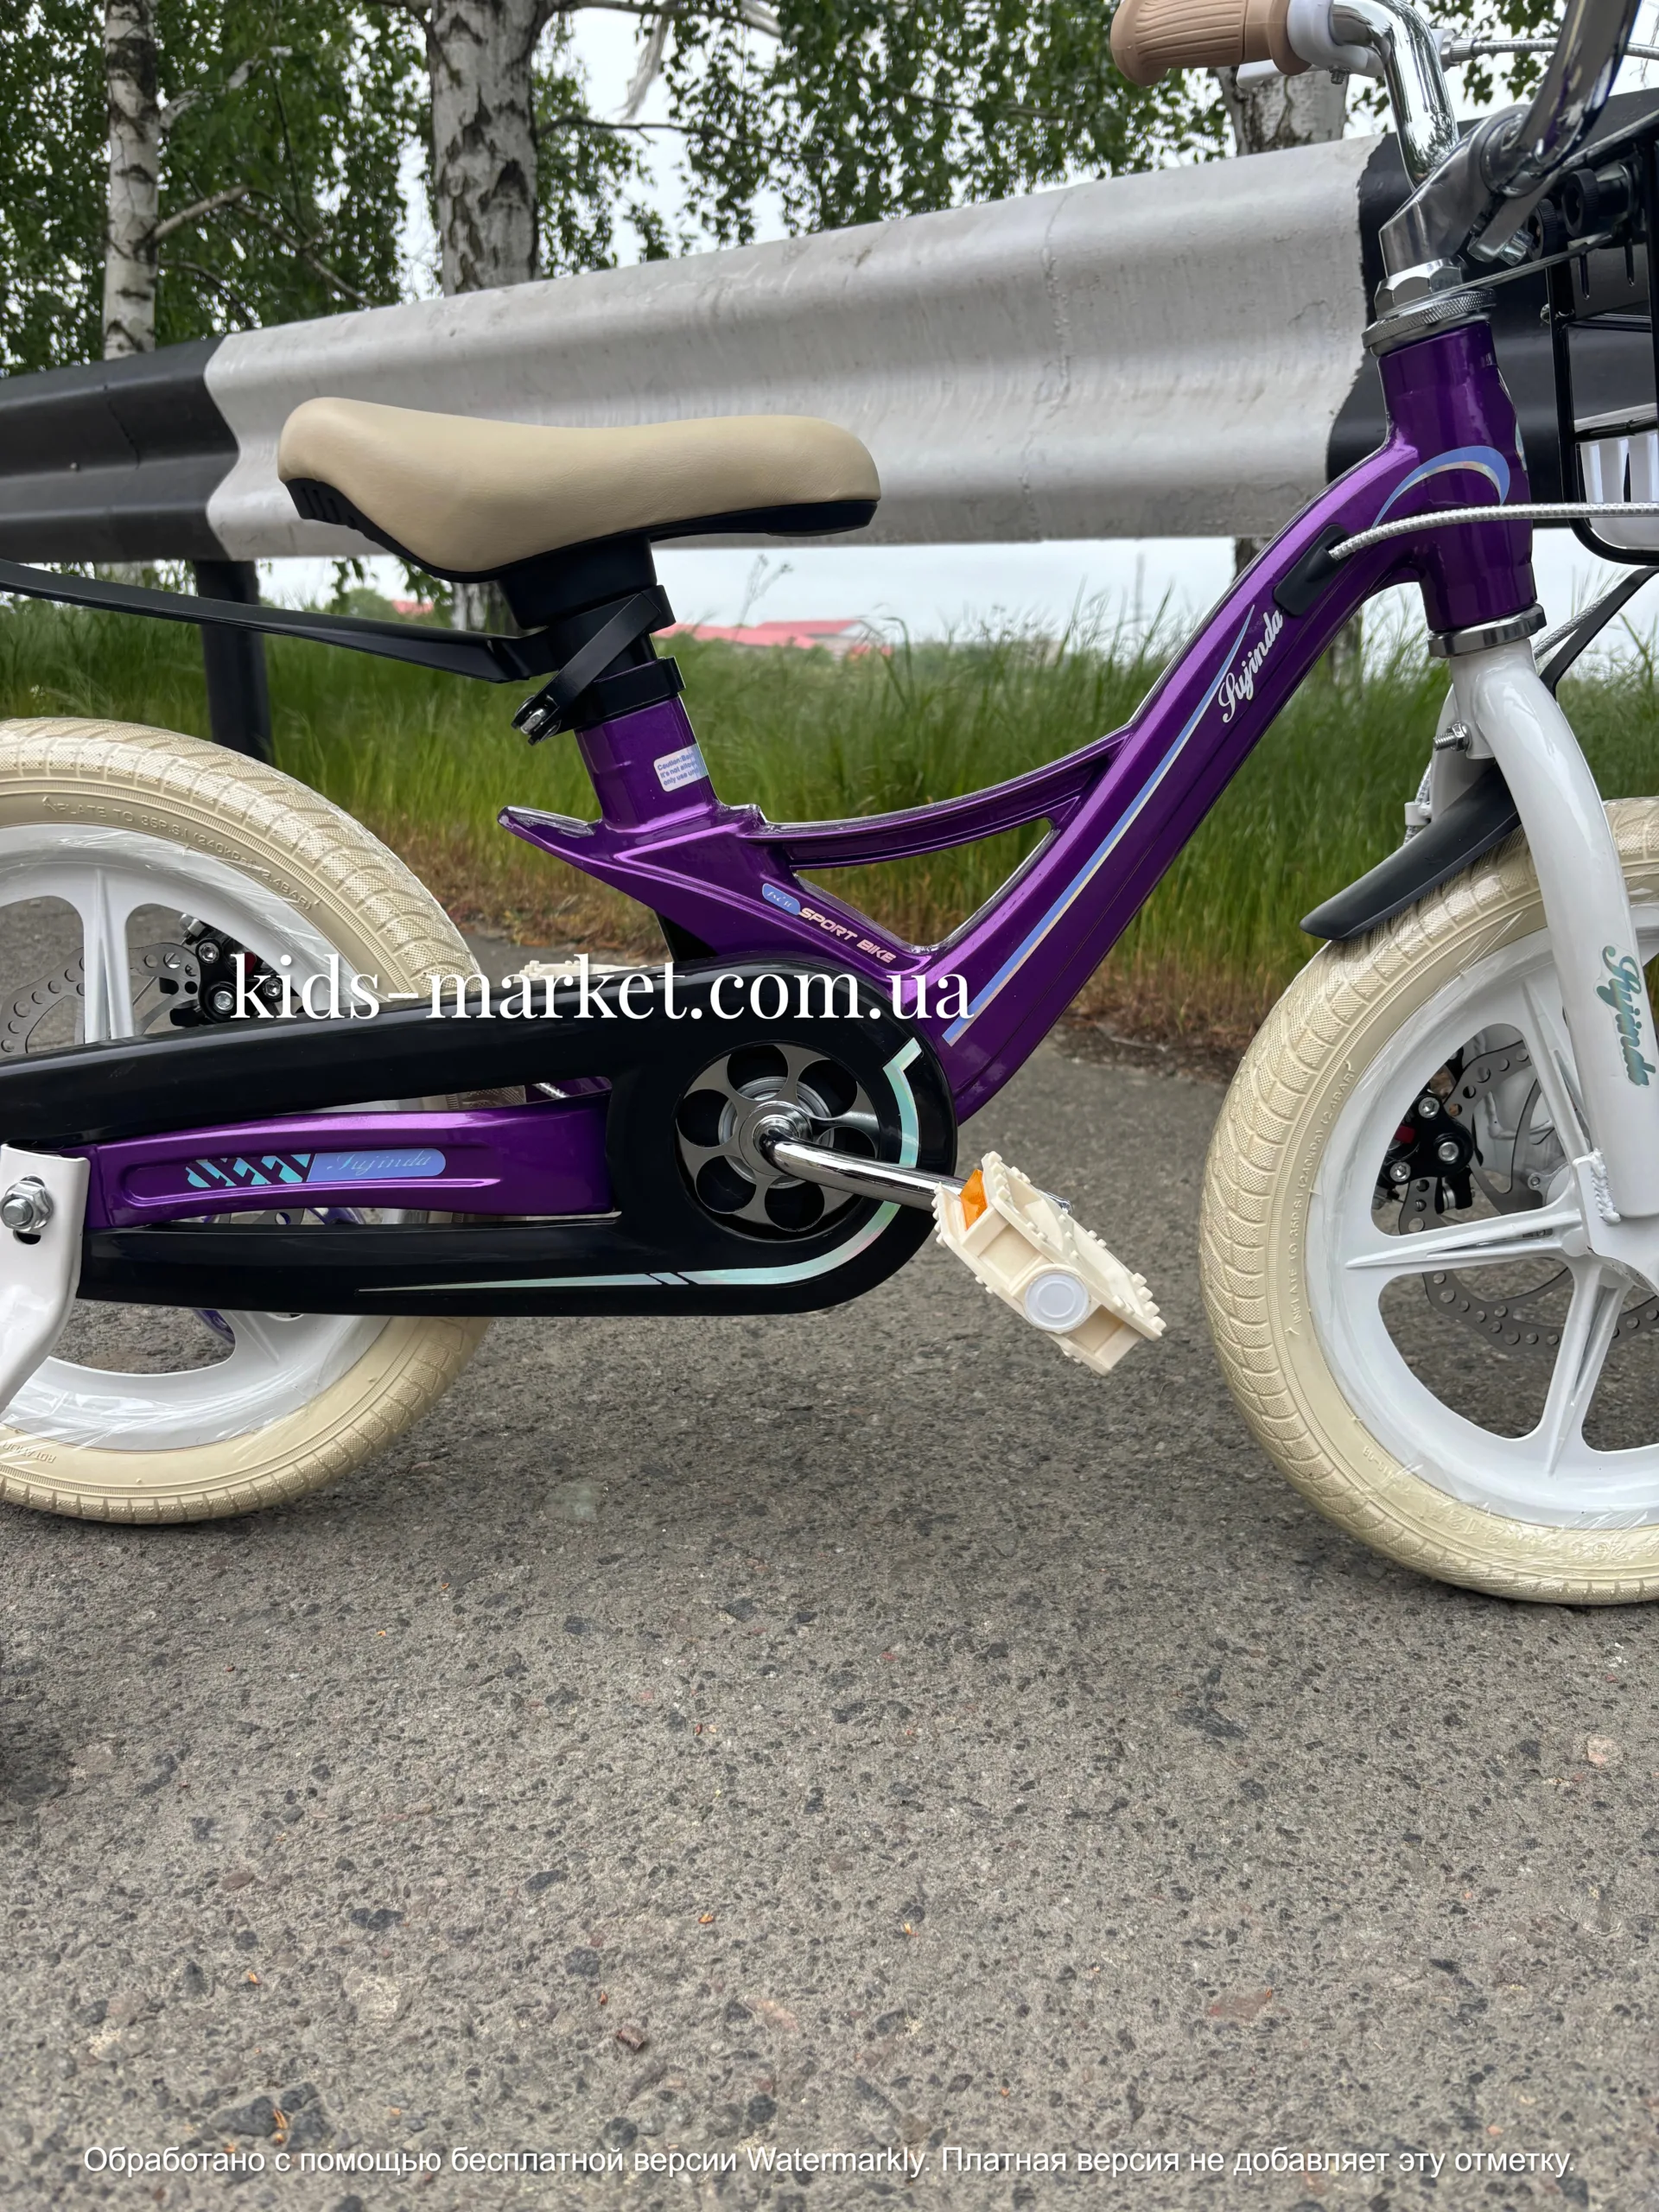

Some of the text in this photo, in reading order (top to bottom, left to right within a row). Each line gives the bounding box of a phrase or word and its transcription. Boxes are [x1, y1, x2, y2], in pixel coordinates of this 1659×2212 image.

[112, 808, 136, 823] TO
[798, 907, 897, 963] SPORT BIKE
